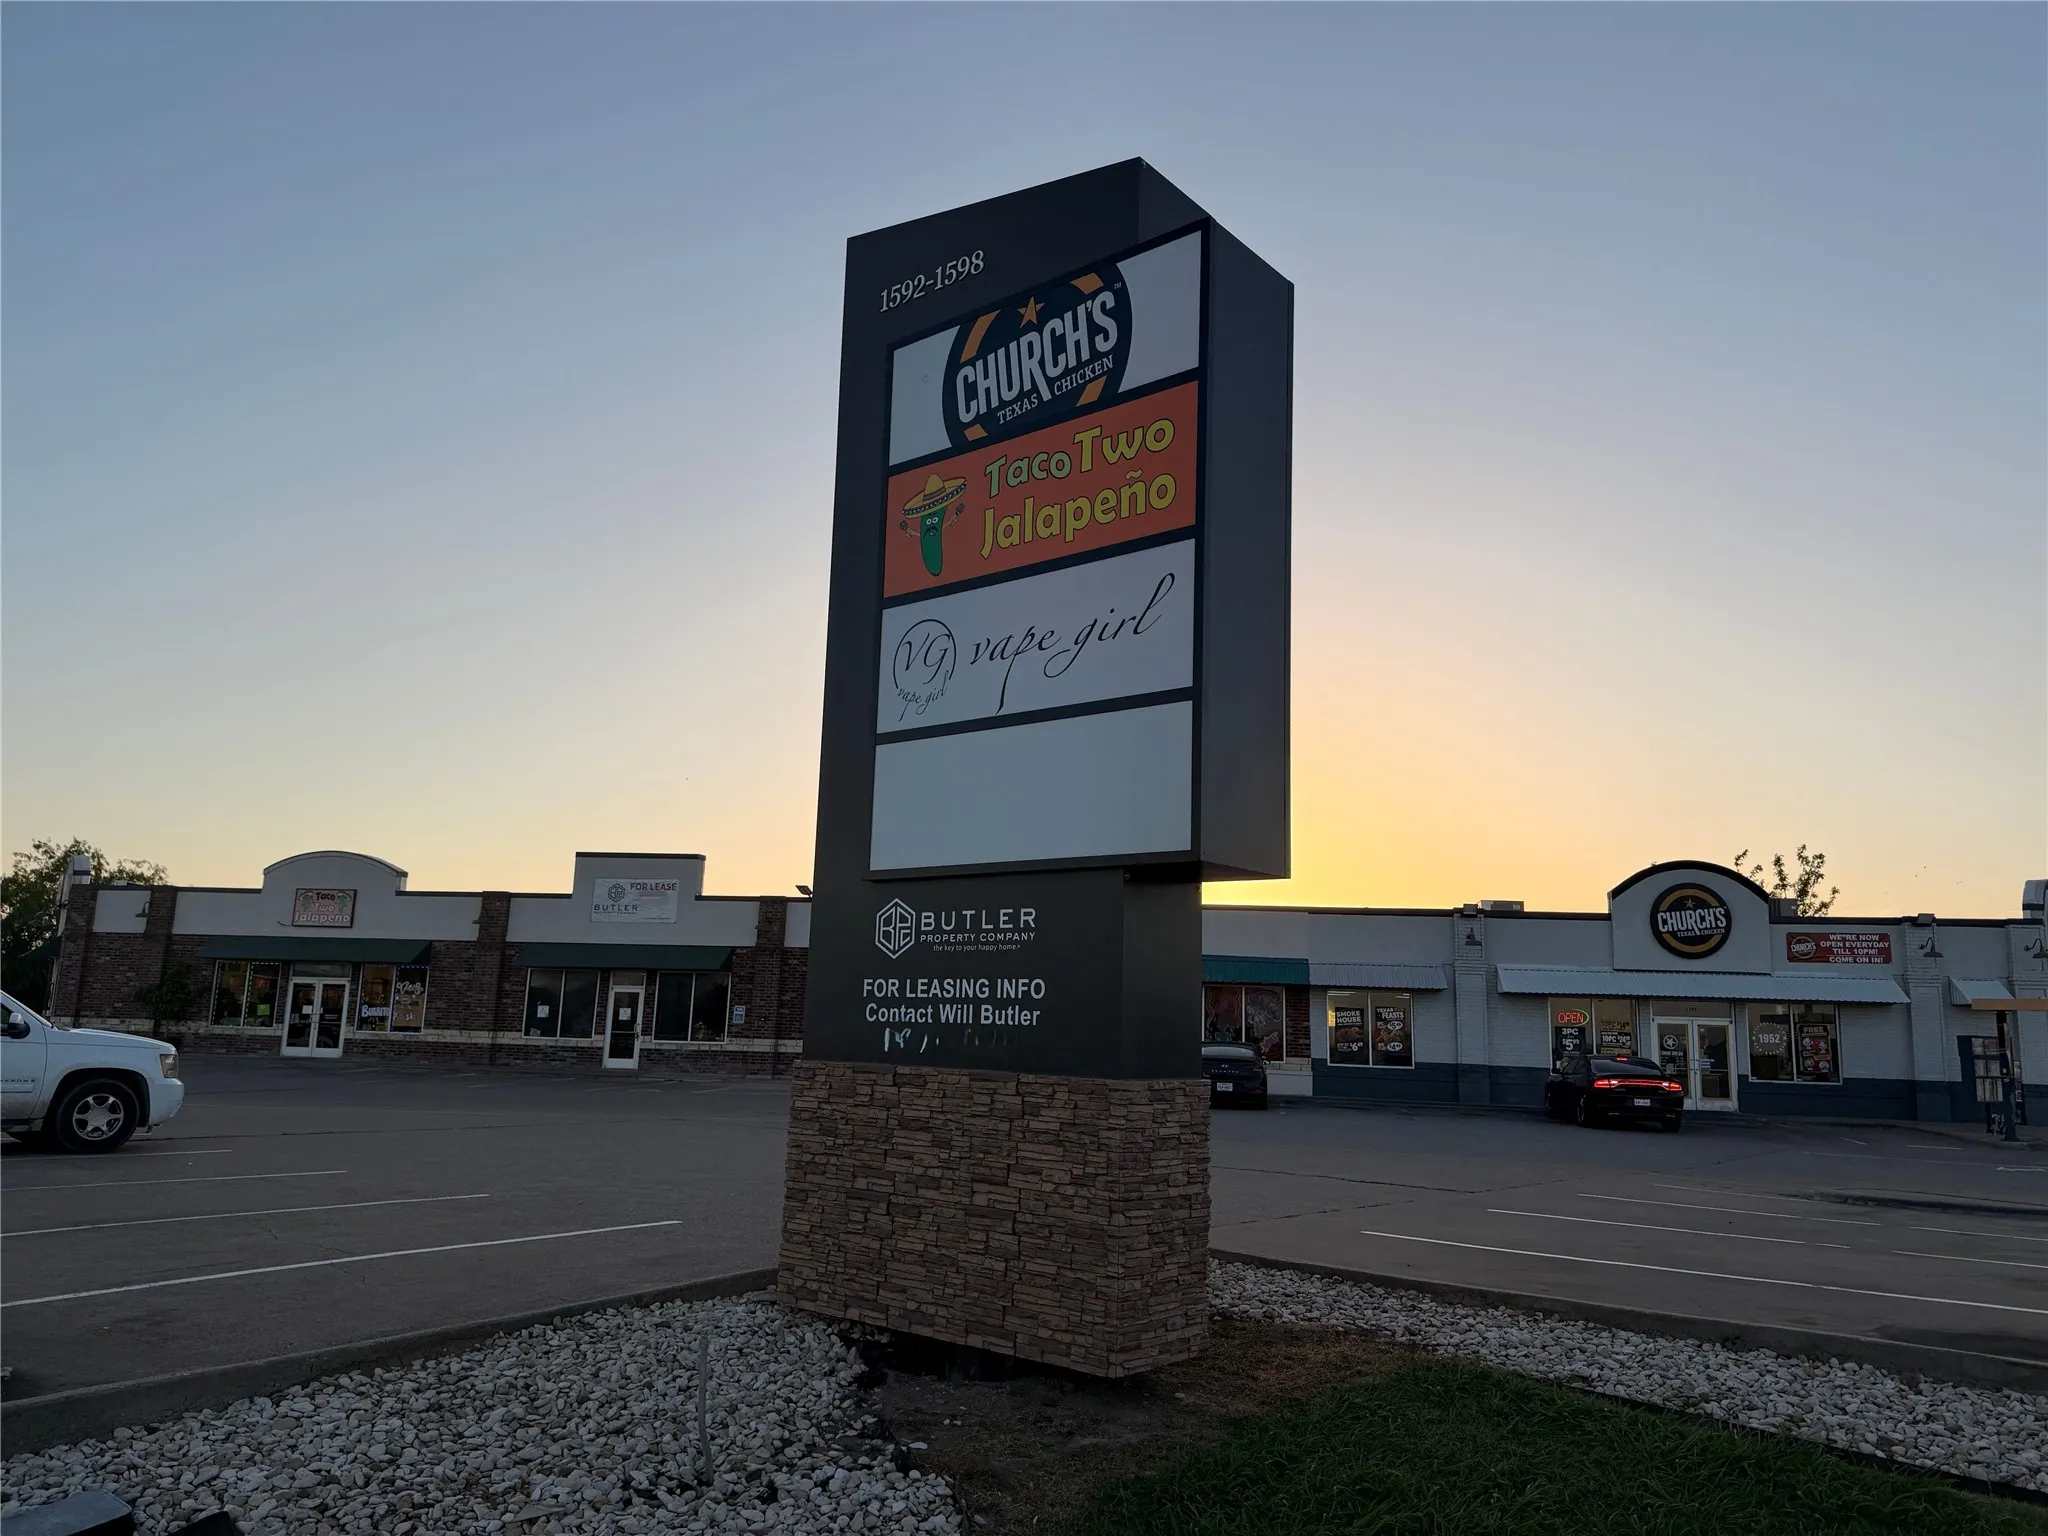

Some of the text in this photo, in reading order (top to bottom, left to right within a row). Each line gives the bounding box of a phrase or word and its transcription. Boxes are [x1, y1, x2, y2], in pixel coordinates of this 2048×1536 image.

[880, 250, 985, 312] 1592-1598
[956, 290, 1118, 424] CHURCH'S
[997, 355, 1114, 425] TEXAS CHICKEN
[984, 418, 1176, 499] Taco Two
[980, 468, 1177, 560] Jalapeño
[970, 572, 1175, 715] vape girl
[901, 632, 951, 685] VG
[315, 892, 336, 901] Taco
[630, 882, 677, 891] FOR LEASE
[594, 903, 638, 912] BUTLER
[921, 908, 1036, 930] BUTLER
[1657, 906, 1727, 936] CHURCH'S
[920, 932, 1036, 943] PROPERTY COMPANY
[963, 944, 977, 952] your
[978, 943, 998, 952] happy
[863, 978, 1045, 999] FOR LEASING INFO
[865, 1002, 1040, 1026] Contact Will Butler
[1557, 1012, 1584, 1024] OPEN
[1758, 1034, 1780, 1043] 1952
